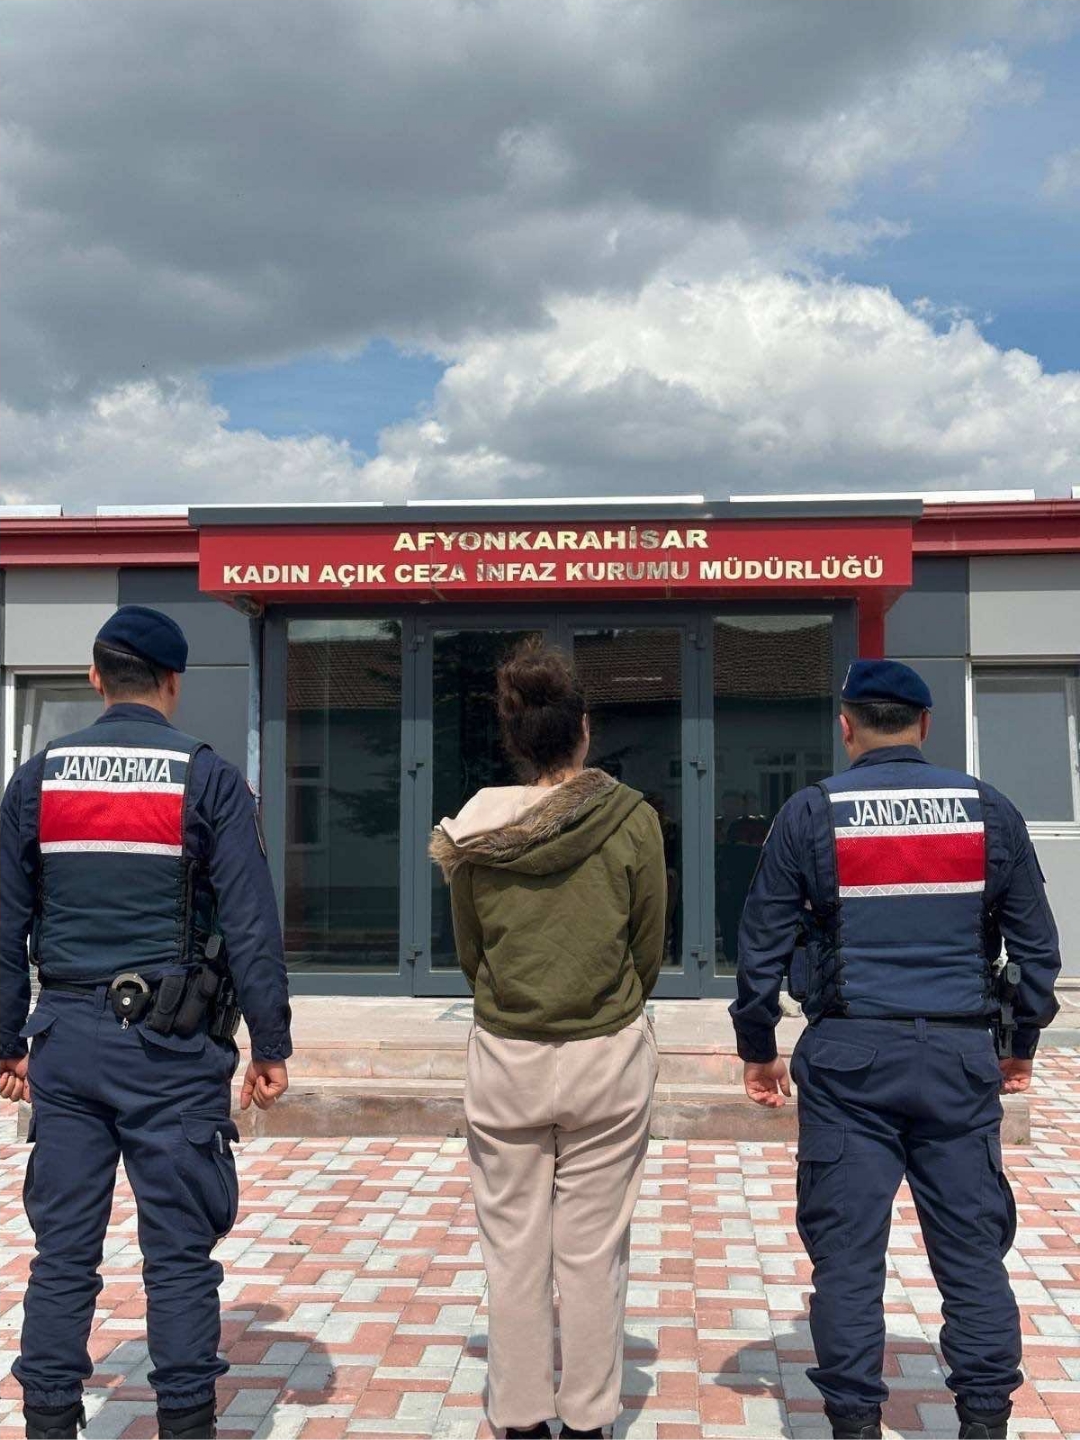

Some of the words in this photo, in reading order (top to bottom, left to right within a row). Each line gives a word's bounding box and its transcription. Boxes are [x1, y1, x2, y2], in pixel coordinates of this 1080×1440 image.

[393, 525, 709, 551] AFYONKARAHİSAR
[223, 564, 310, 584] KADIN
[318, 563, 386, 588] AÇIK
[394, 562, 467, 582] CEZA
[476, 558, 557, 582] İNFAZ
[565, 561, 690, 581] KURUMU
[699, 555, 884, 580] MÜDÜRLÜĞÜ
[54, 755, 172, 782] JANDARMA
[848, 797, 970, 827] JANDARMA
